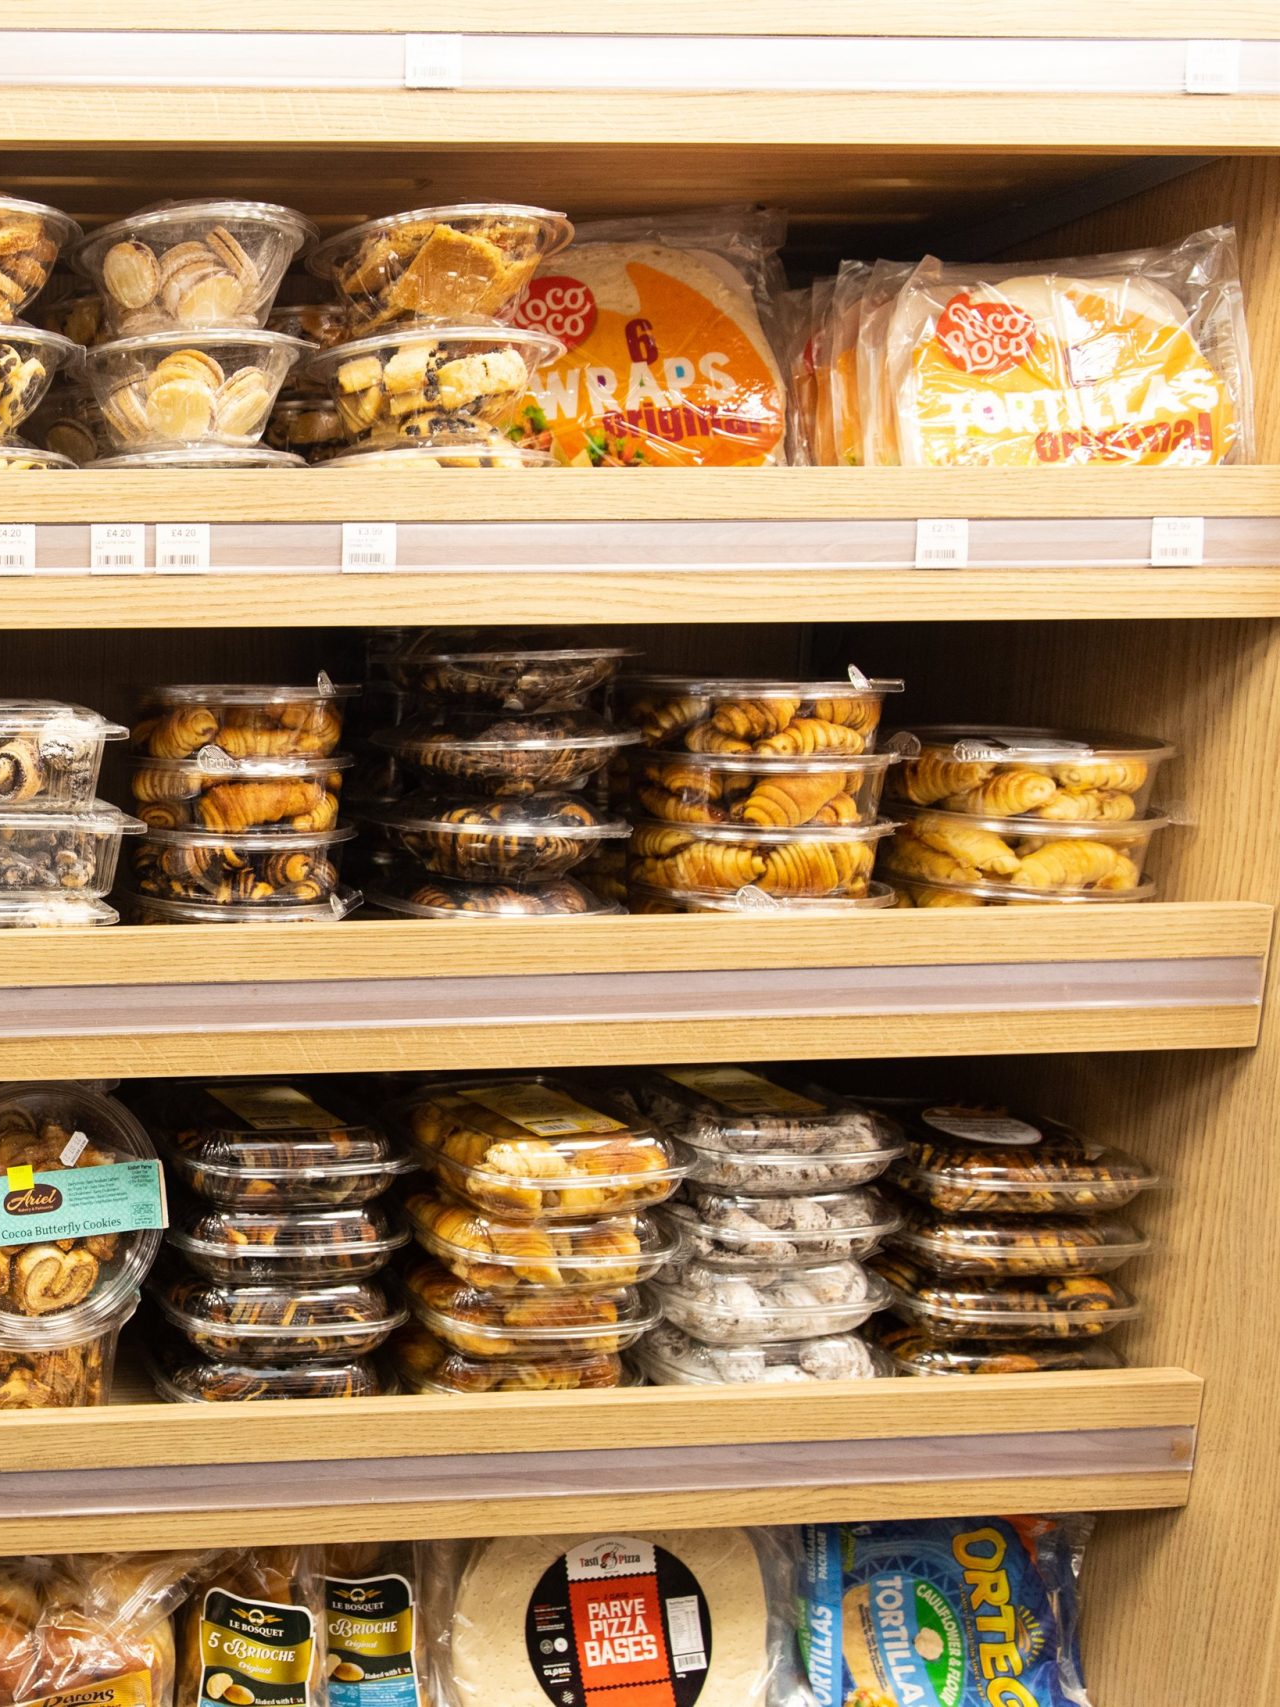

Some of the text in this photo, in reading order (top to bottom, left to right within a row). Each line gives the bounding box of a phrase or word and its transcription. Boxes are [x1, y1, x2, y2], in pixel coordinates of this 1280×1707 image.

[624, 318, 659, 365] 6
[945, 330, 1031, 374] Loco
[532, 351, 738, 421] WRAPS
[940, 368, 1220, 437] TORTILLAS
[1035, 412, 1214, 463] original
[106, 528, 132, 537] £4.20
[171, 528, 197, 537] £4.20
[6, 1189, 56, 1211] Ariel
[1, 1228, 33, 1240] Cocoa
[35, 1222, 81, 1236] Butterfly
[83, 1217, 122, 1231] Cookies
[618, 1554, 641, 1565] Pizza
[808, 1525, 816, 1583] RESEALABL
[817, 1532, 827, 1579] PACKAGE
[332, 1601, 384, 1613] LE BOSQUET
[587, 1597, 646, 1620] PARVE
[229, 1620, 285, 1638] LE BOSQUET
[328, 1618, 398, 1638] BRIOCHE
[589, 1617, 648, 1640] PIZZA
[208, 1632, 296, 1662] 5 BRIOCHE
[344, 1640, 378, 1649] Original
[584, 1634, 659, 1668] BASES
[876, 1576, 928, 1707] TORTILLA
[916, 1584, 964, 1707] CAULIFLOWER & FLOUR
[238, 1661, 273, 1675] Original
[808, 1606, 832, 1707] ORTILLAS
